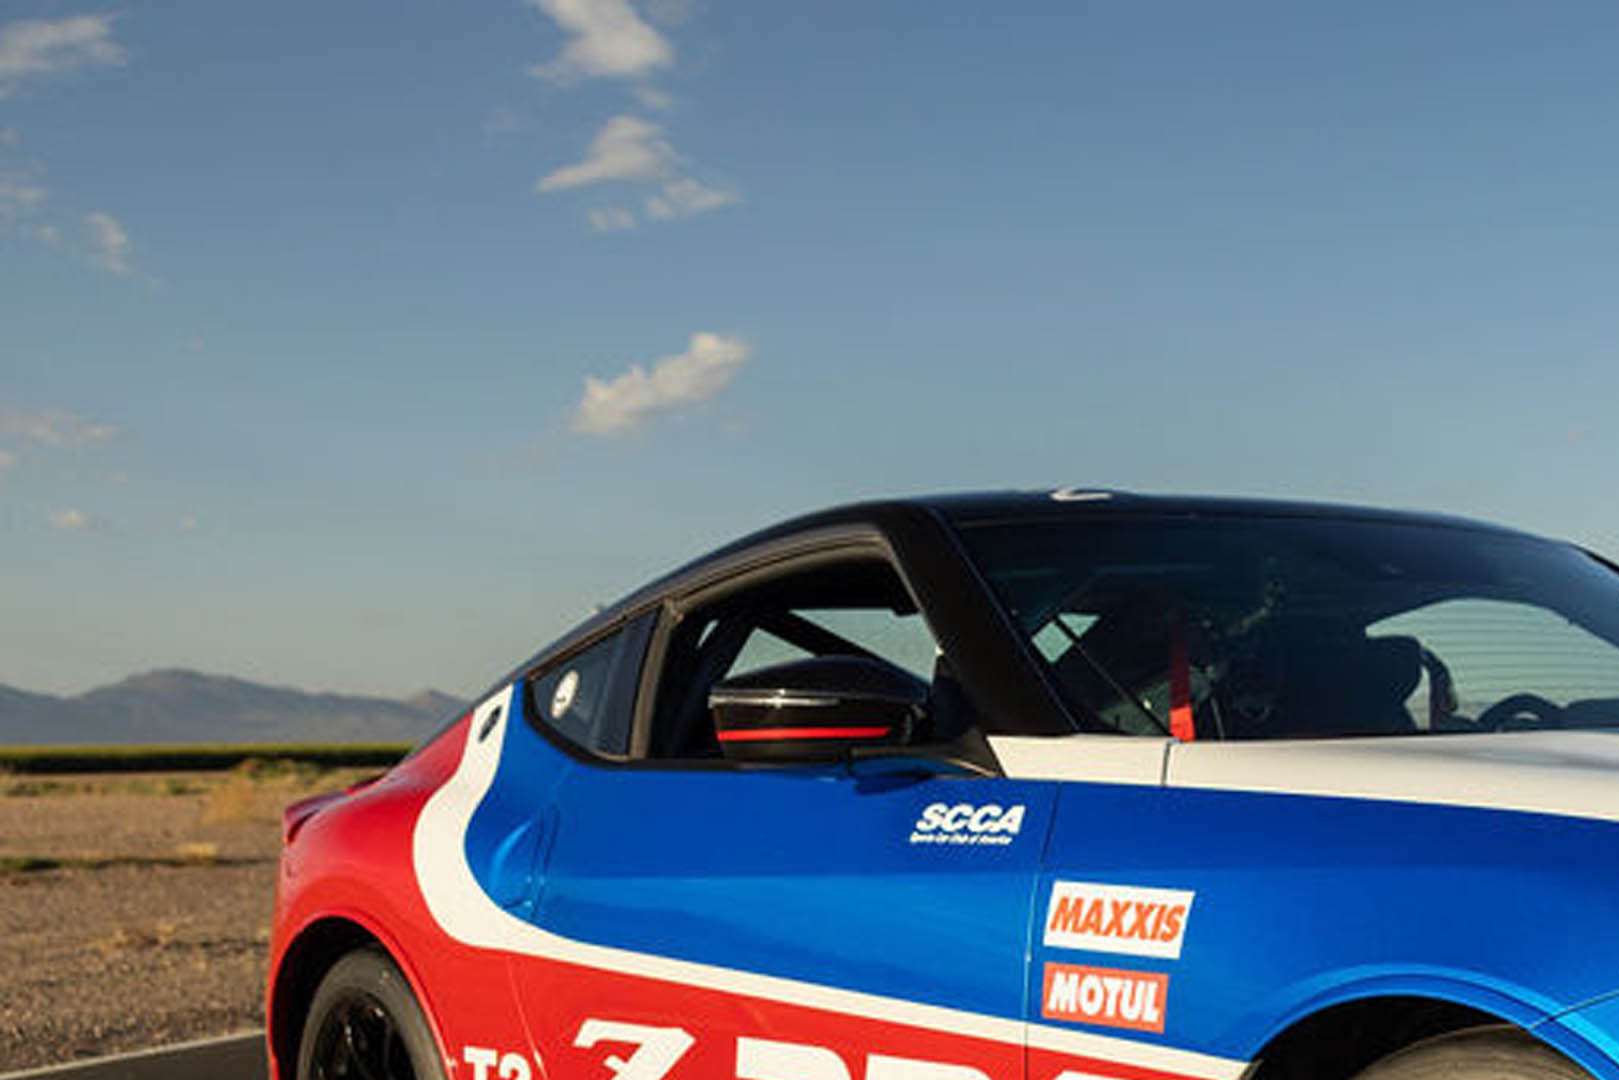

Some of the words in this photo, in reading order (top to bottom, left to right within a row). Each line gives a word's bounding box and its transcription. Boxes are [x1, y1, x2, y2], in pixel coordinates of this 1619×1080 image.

[916, 803, 1026, 835] SCCA
[1050, 897, 1186, 943] MAXXIS
[1048, 970, 1161, 1023] MOTUL
